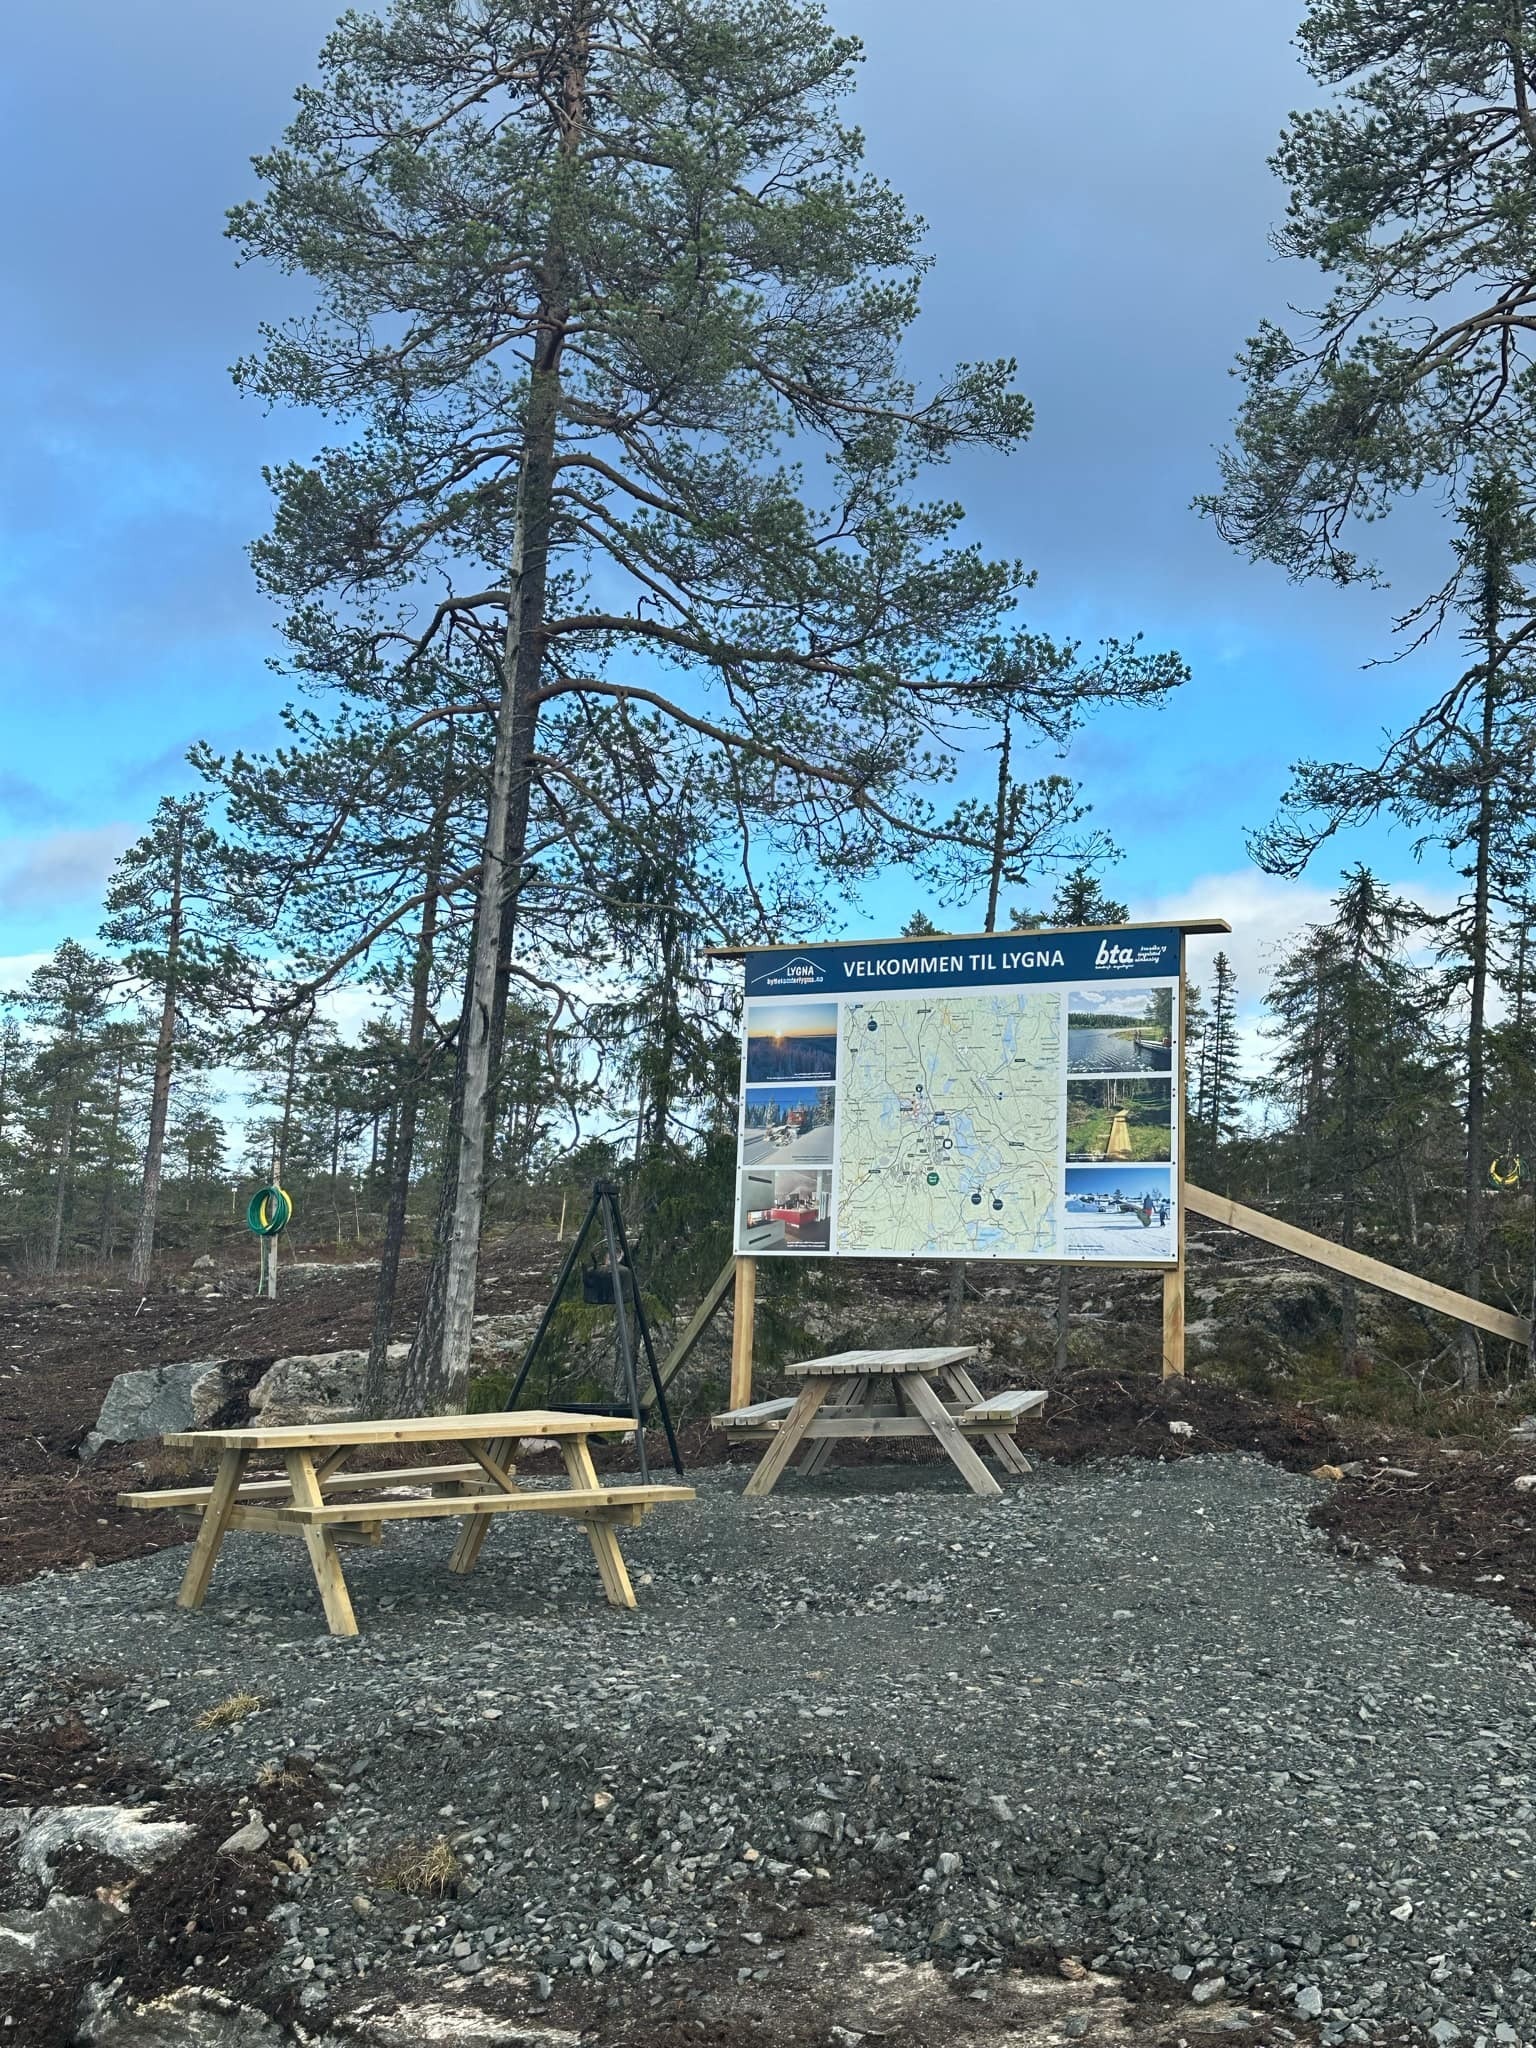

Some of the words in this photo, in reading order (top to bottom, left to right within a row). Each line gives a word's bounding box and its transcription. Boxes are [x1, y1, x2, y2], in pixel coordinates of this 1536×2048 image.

[843, 955, 964, 977] VELKOMMEN
[969, 953, 997, 971] TIL
[1002, 950, 1065, 969] LYGNA
[1095, 939, 1134, 965] bta
[787, 966, 815, 976] LYGNA
